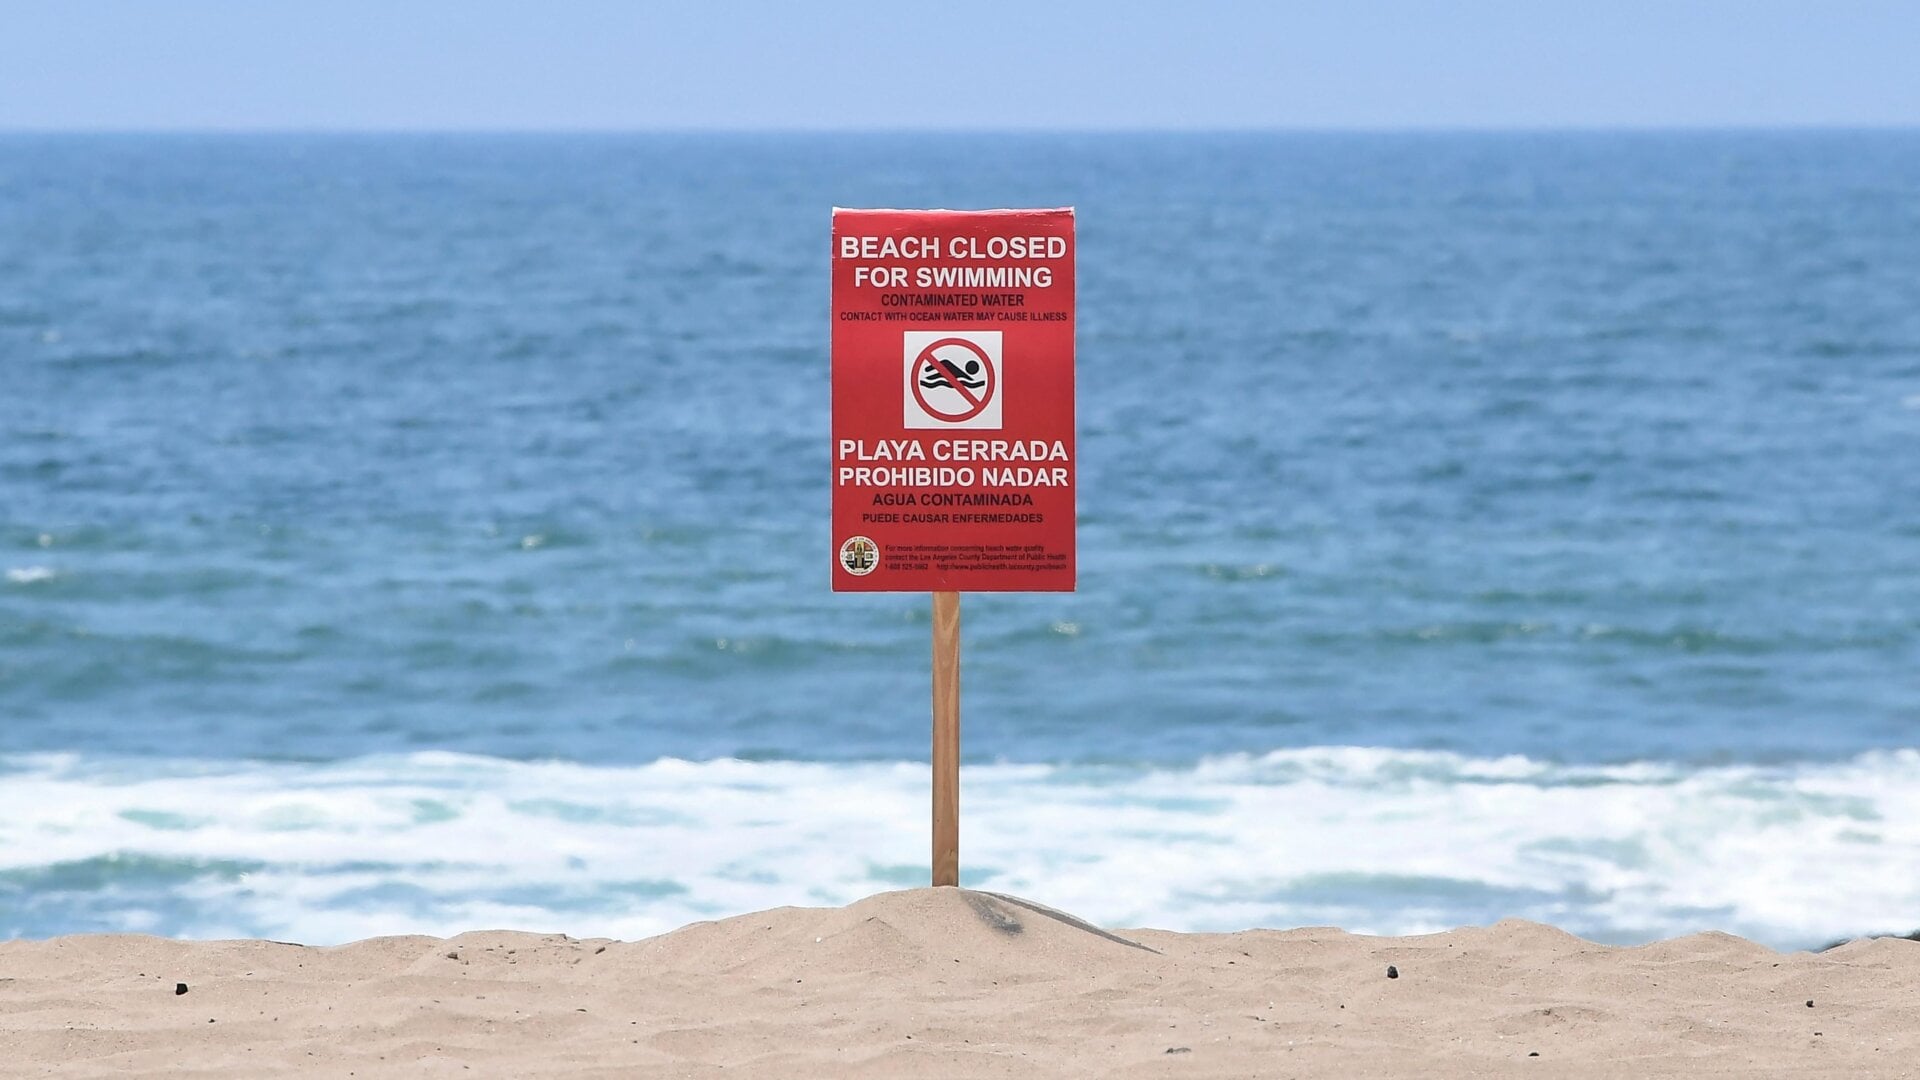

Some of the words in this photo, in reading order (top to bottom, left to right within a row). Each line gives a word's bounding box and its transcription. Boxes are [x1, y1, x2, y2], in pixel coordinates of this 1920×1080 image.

[841, 237, 939, 259] BEACH
[949, 237, 1066, 259] CLOSED
[855, 267, 909, 287] FOR
[916, 267, 1052, 287] SWIMMING
[881, 294, 978, 306] CONTAMINATED
[981, 294, 1024, 306] WATER
[840, 312, 882, 321] CONTACT
[885, 312, 907, 321] WITH
[910, 312, 940, 321] OCEAN
[943, 312, 974, 321] WATER
[977, 312, 995, 321] MAY
[997, 313, 1028, 321] CAUSE
[1030, 312, 1067, 321] ILLNESS
[839, 440, 926, 461] PLAYA
[933, 440, 1068, 461] CERRADA
[839, 467, 975, 486] PROHIBIDO
[982, 467, 1068, 486] NADAR
[872, 494, 916, 506] AGUA
[920, 494, 1033, 506] CONTAMINADA
[863, 514, 899, 523] PUEDE
[903, 514, 949, 523] CAUSAR
[952, 514, 1043, 523] ENFERMEDADES
[959, 554, 980, 562] County
